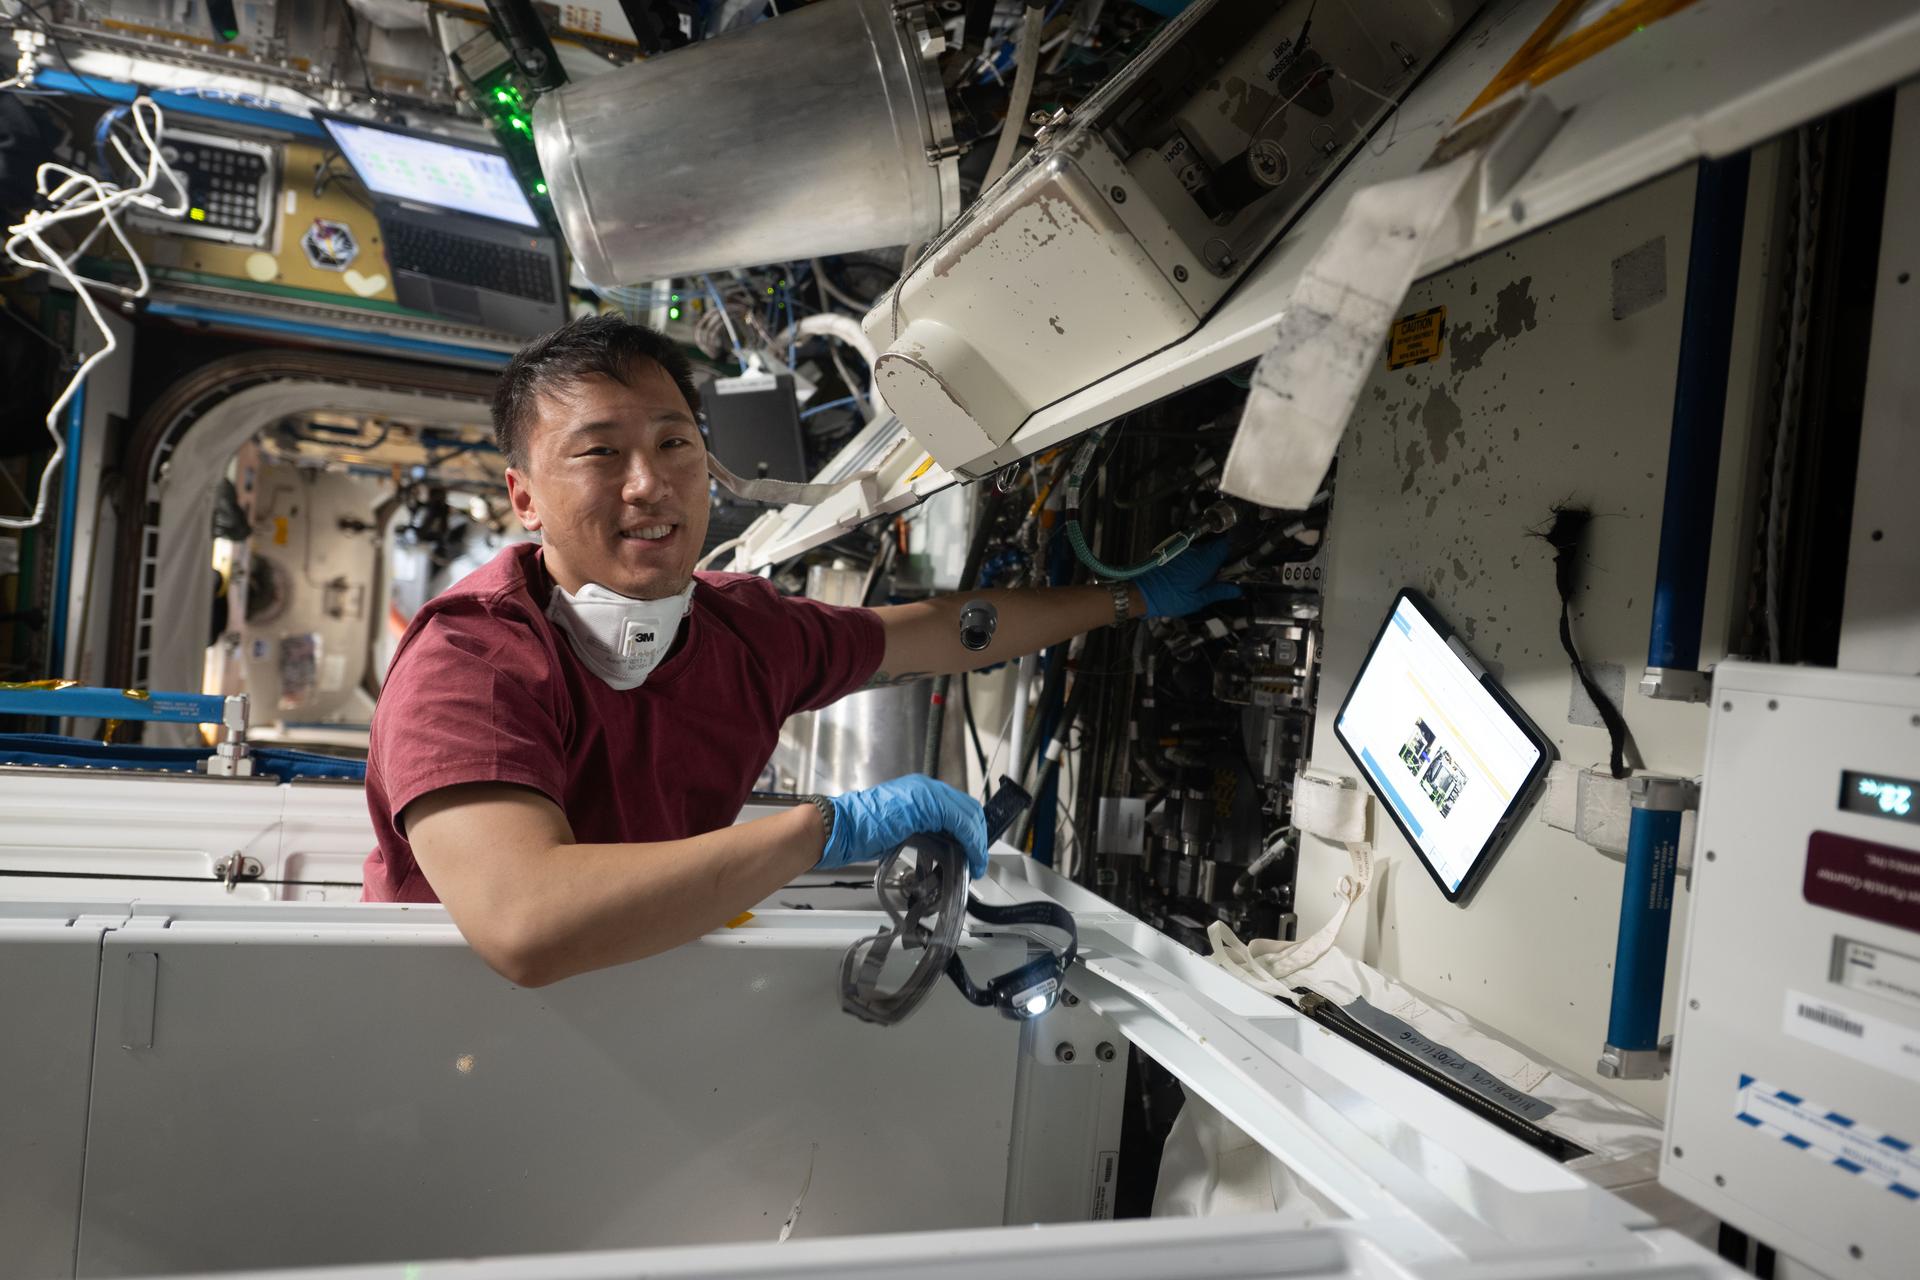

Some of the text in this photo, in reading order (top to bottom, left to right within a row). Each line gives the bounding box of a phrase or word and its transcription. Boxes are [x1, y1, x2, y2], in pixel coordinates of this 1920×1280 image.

[1272, 38, 1292, 58] PORT
[1401, 316, 1433, 334] CAUTION
[635, 632, 654, 642] 3M
[1816, 868, 1864, 889] Counter
[1864, 879, 1906, 900] Particle
